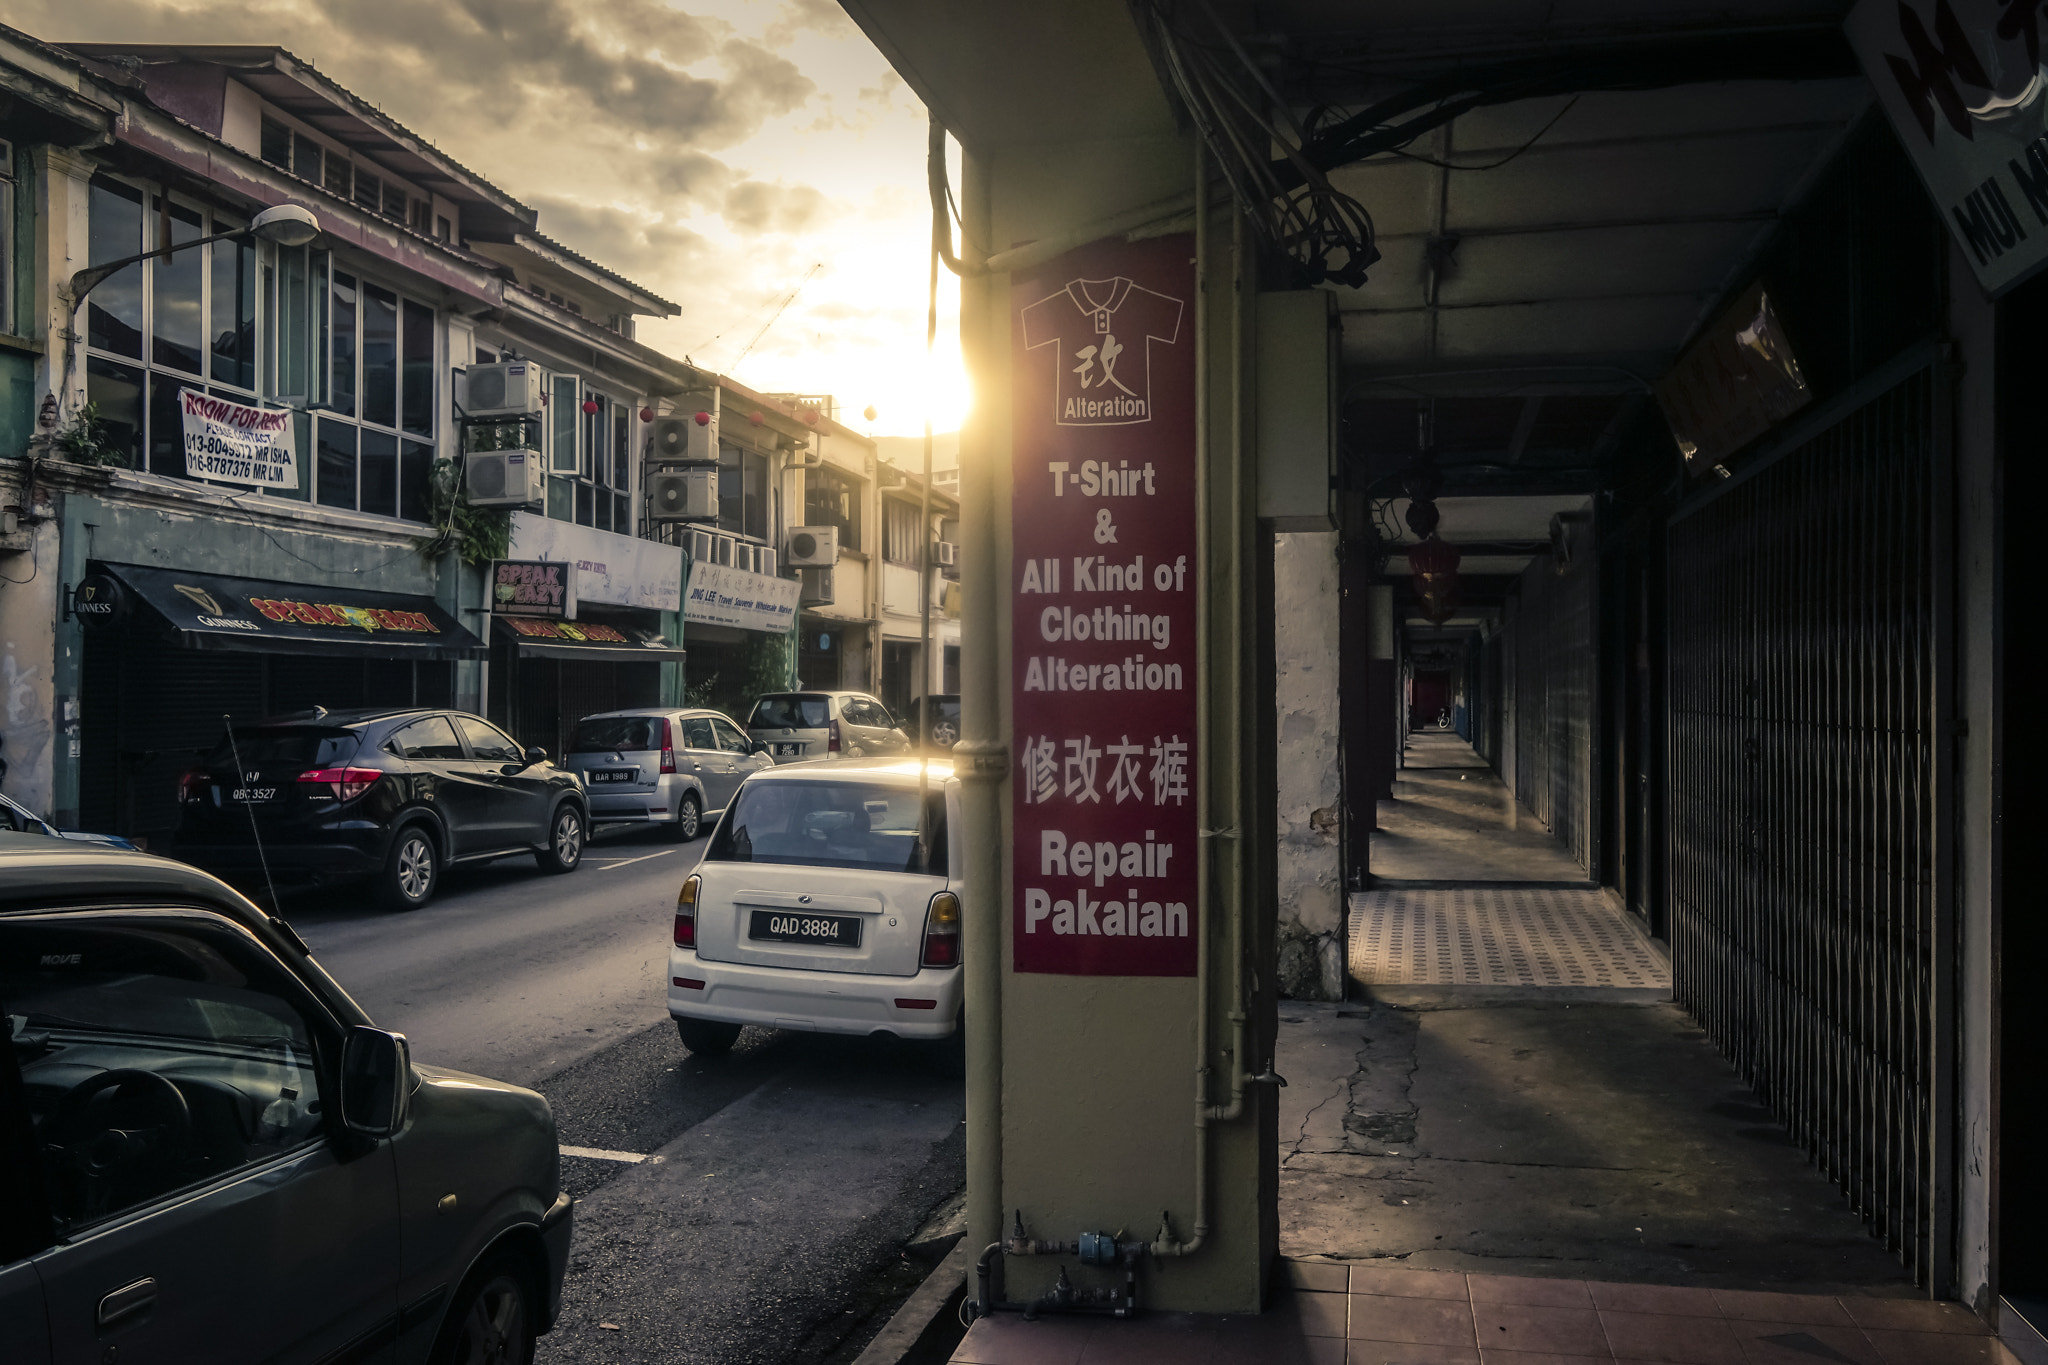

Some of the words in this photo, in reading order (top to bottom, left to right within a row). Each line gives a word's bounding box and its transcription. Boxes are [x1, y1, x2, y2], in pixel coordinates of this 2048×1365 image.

[1952, 176, 2027, 267] MUI
[1073, 334, 1138, 397] 改
[186, 393, 231, 423] ROOM
[228, 407, 259, 429] FOR
[256, 412, 287, 431] RENT
[1064, 394, 1146, 419] Alteration
[206, 422, 234, 439] PLEASE
[234, 430, 271, 444] CONTACT
[187, 452, 251, 478] 016-8787376
[253, 463, 267, 481] MR
[268, 466, 284, 482] LIM
[255, 445, 268, 462] MR
[270, 447, 292, 465] ISHA
[1049, 460, 1156, 497] T-Shirt
[1094, 508, 1118, 545] &
[497, 565, 559, 586] SPEAK
[1020, 558, 1060, 594] All
[1073, 555, 1144, 592] Kind
[1153, 555, 1187, 592] of
[515, 584, 565, 605] EAZY
[690, 588, 705, 600] JING
[705, 590, 717, 602] LEE
[718, 595, 733, 606] Travel
[734, 598, 754, 608] Souvenir
[755, 601, 777, 612] Wholesale
[778, 605, 792, 615] Market
[1040, 605, 1170, 650] Clothing
[1023, 654, 1182, 692] Alteration
[595, 773, 609, 781] QAR
[612, 772, 629, 780] 1989
[1021, 734, 1189, 806] 修改衣裤
[232, 788, 251, 800] QBC
[252, 788, 276, 799] 3527
[1041, 829, 1173, 887] Repair
[769, 916, 799, 936] QAD
[801, 918, 840, 938] 3884
[1025, 887, 1189, 937] Pakaian
[39, 953, 82, 966] MOVE
